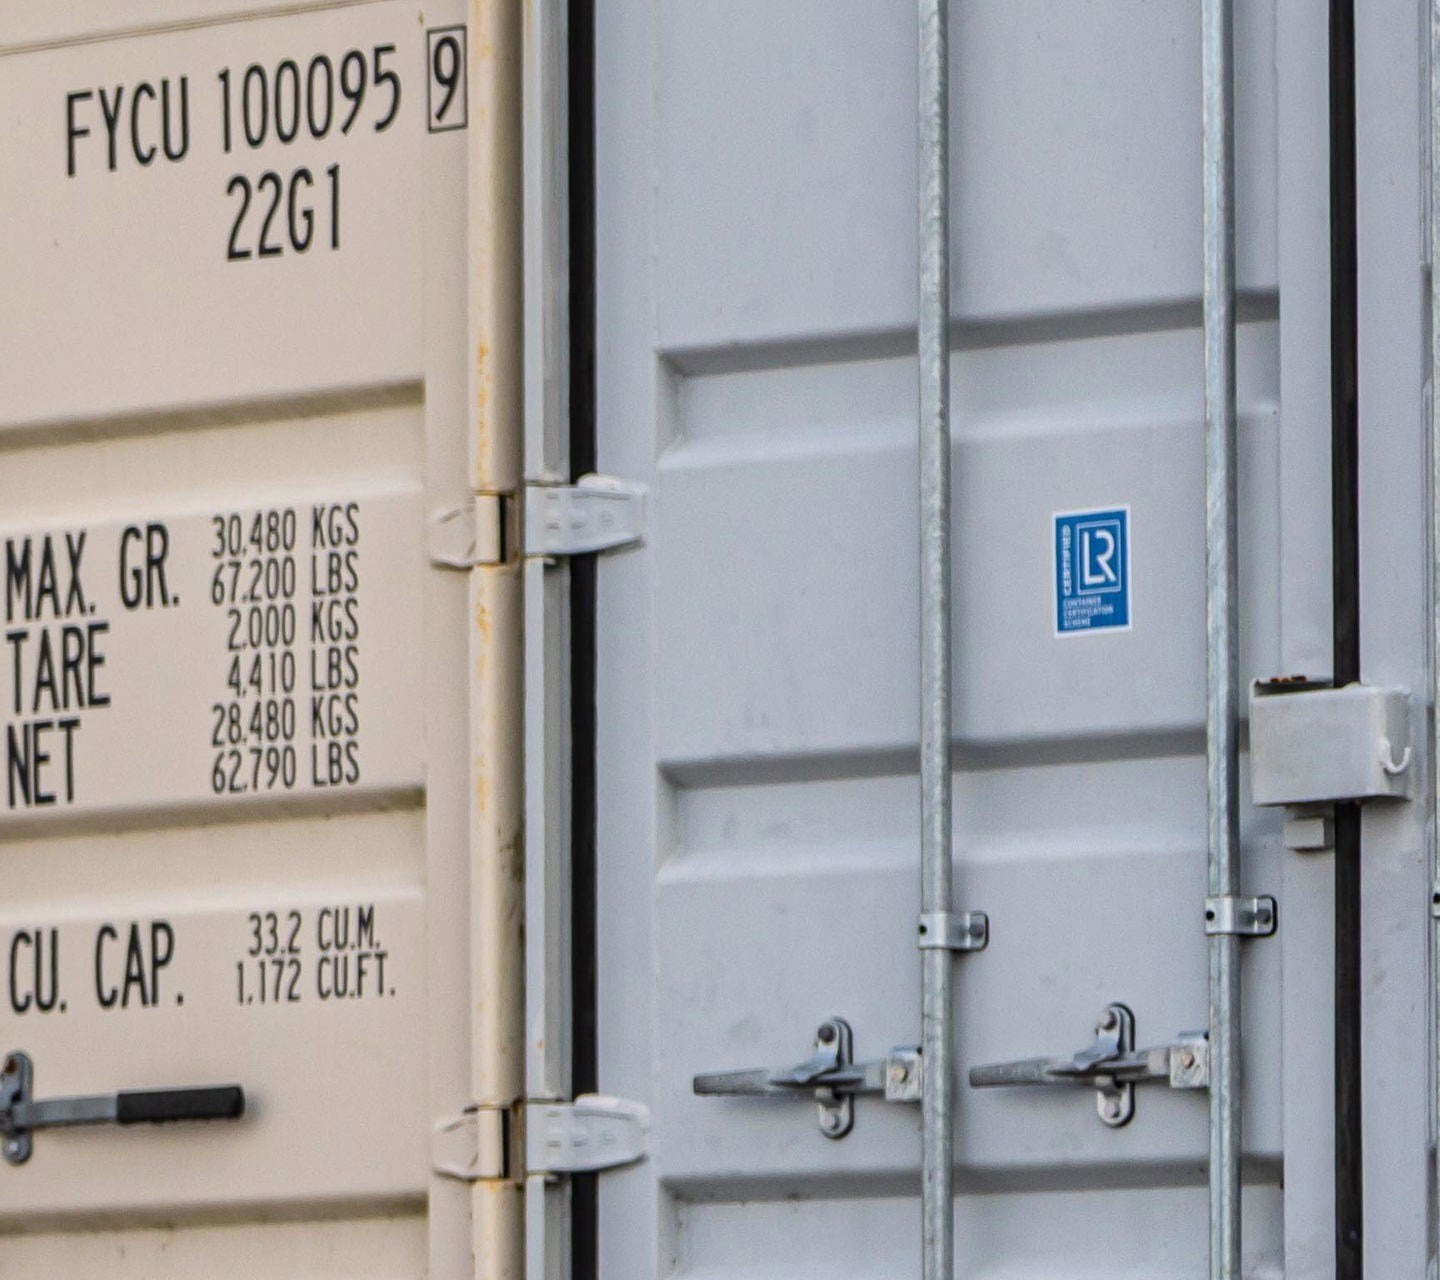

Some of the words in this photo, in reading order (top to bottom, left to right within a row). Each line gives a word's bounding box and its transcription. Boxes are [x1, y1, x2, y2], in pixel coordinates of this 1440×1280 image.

[66, 76, 190, 178] FYCU
[217, 44, 401, 154] 100095
[432, 35, 462, 122] 9
[226, 163, 341, 262] 22G1
[312, 502, 360, 549] KGS
[5, 529, 97, 625] MAX.
[119, 522, 179, 610] GR.
[311, 551, 359, 597] LBS
[1082, 529, 1117, 586] LR
[311, 597, 359, 644] KGS
[5, 620, 111, 715] TARE
[311, 645, 359, 692] LBS
[311, 693, 359, 739] KGS
[6, 718, 81, 809] NET
[312, 740, 360, 788] LBS
[249, 910, 302, 957] 33.2
[317, 904, 382, 952] CU.M.
[9, 928, 68, 1014] CU.
[94, 921, 185, 1010] CAP.
[317, 950, 396, 1000] CU.FT.
